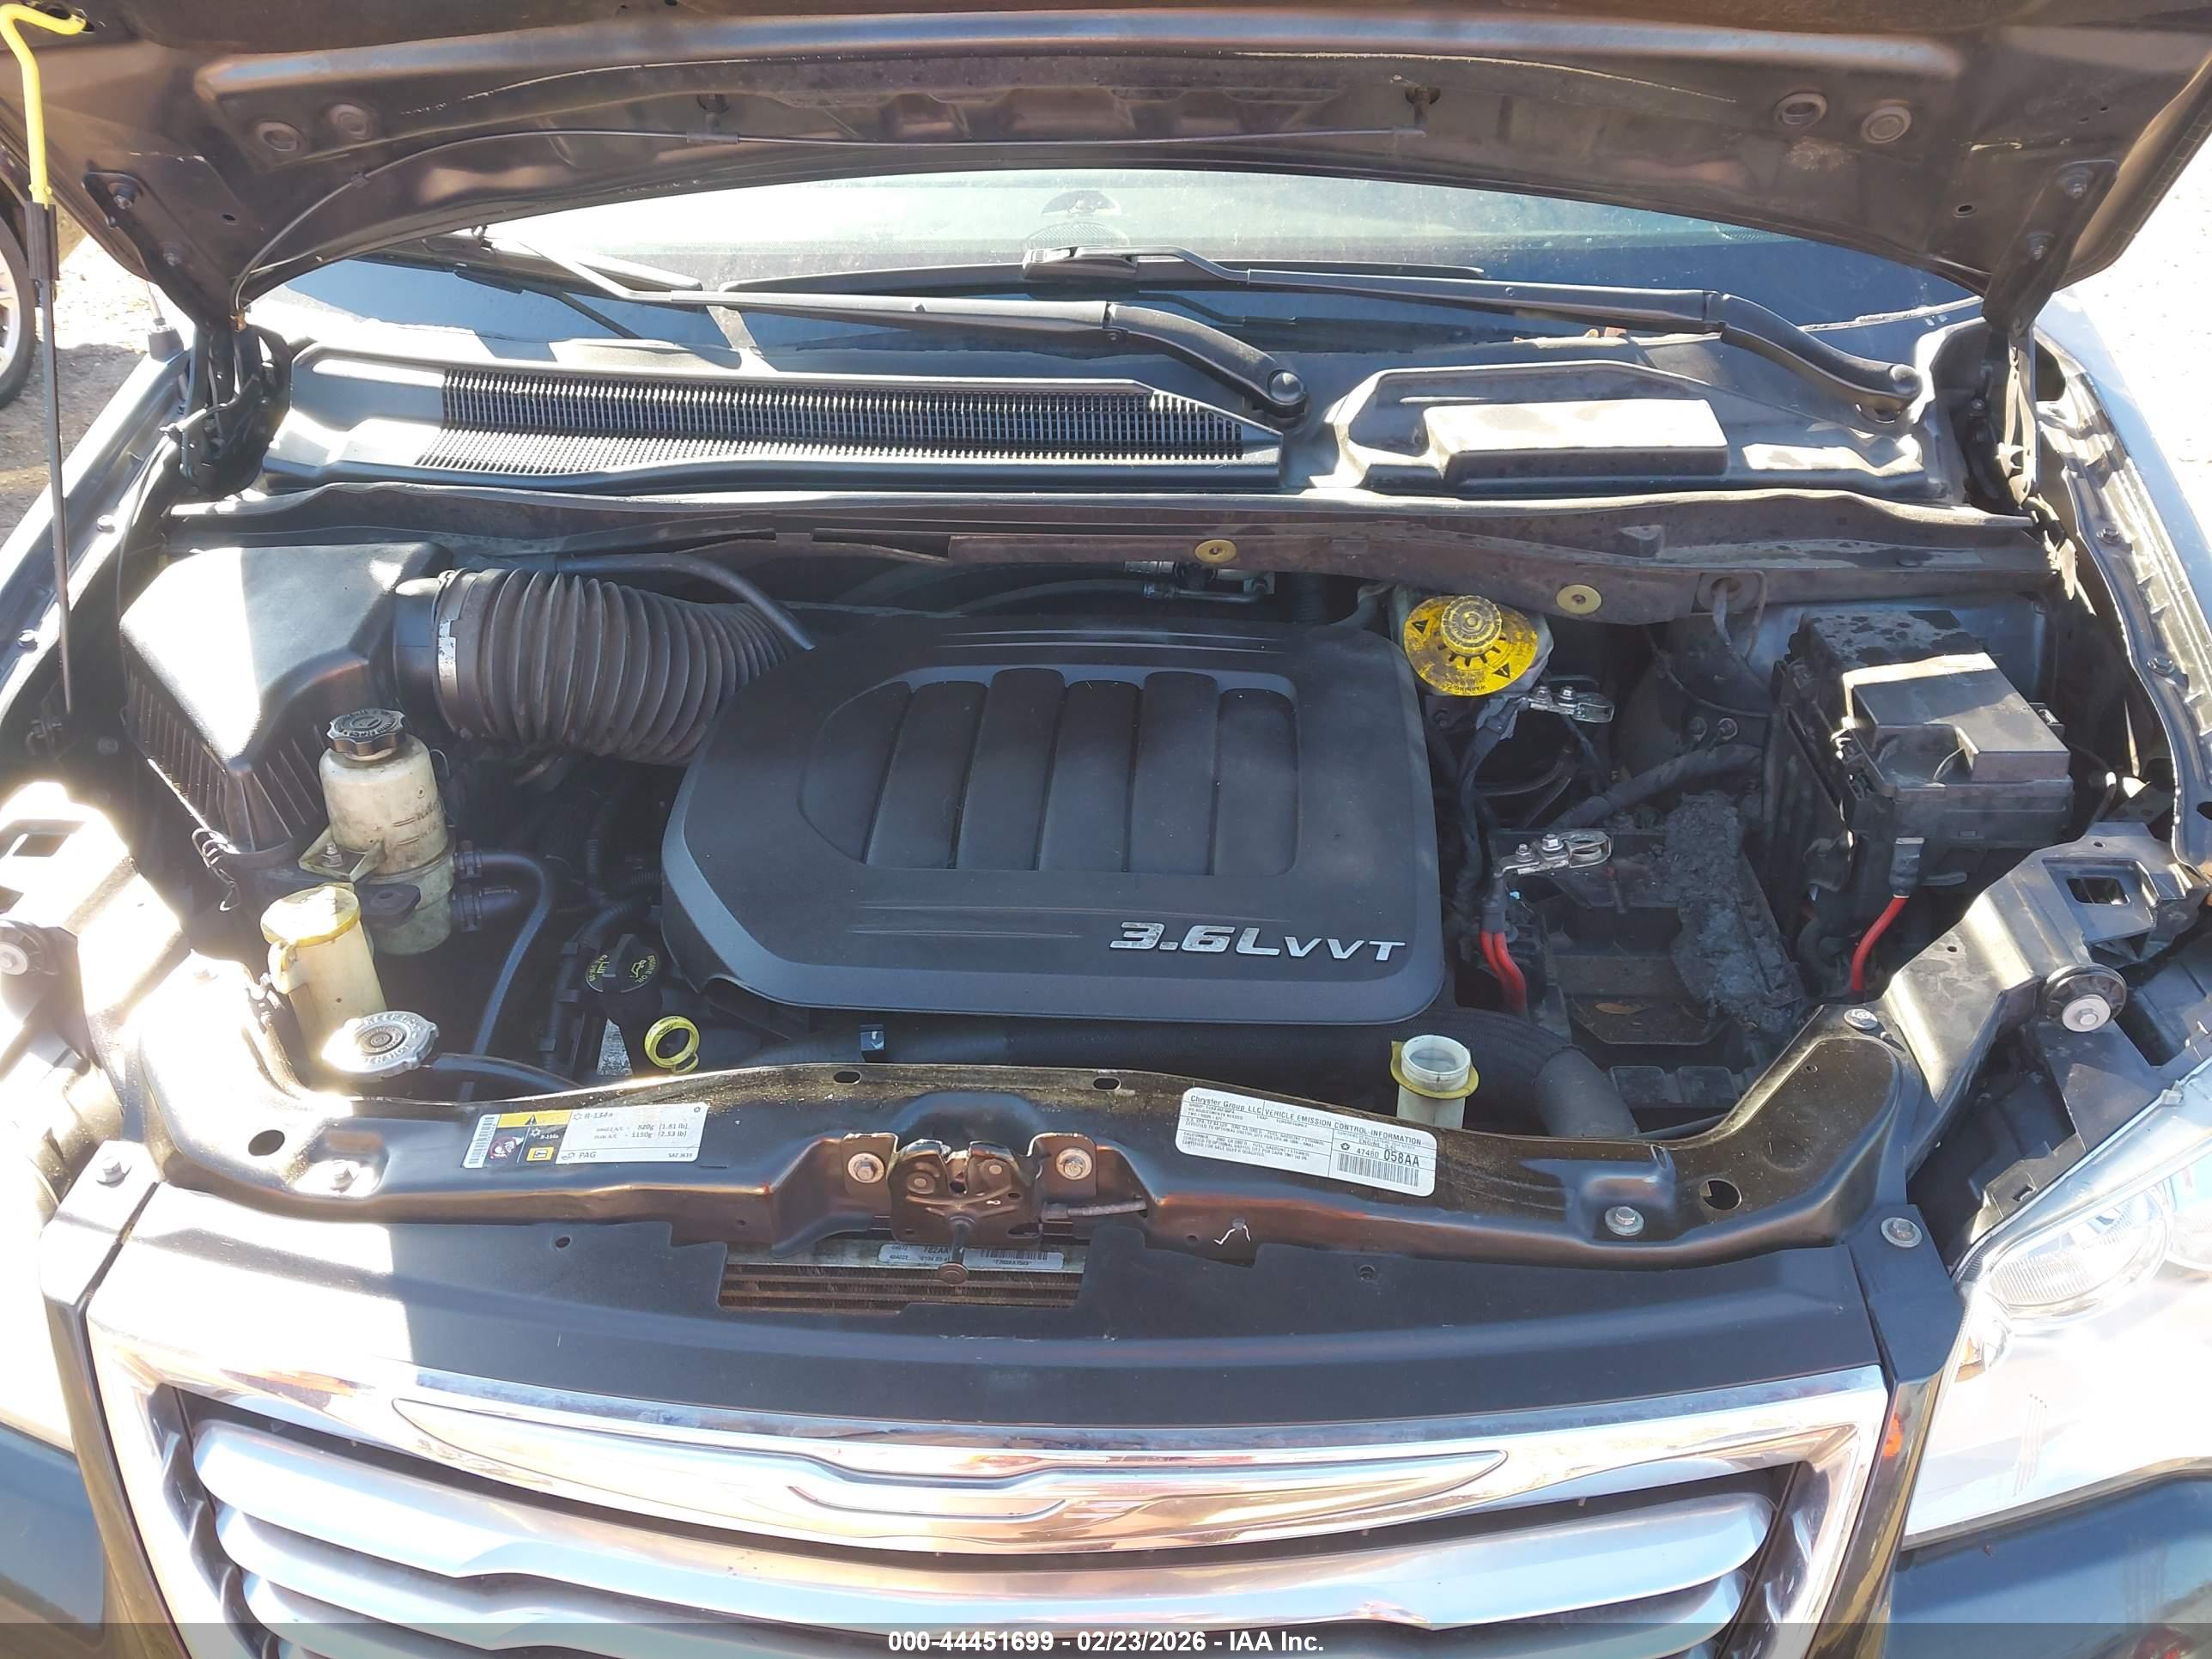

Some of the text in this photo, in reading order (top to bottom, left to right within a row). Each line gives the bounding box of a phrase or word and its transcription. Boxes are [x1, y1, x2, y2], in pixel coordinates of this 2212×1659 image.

[1109, 921, 1407, 961] 3.6L VVT
[1223, 1102, 1244, 1110] Group
[1264, 1109, 1294, 1119] VEHICLE
[1297, 1115, 1331, 1126] EMISSION
[1334, 1122, 1367, 1133] CONTROL
[1370, 1130, 1421, 1144] INFORMATION
[579, 1151, 597, 1159] PAG
[1383, 1150, 1419, 1165] 058AA
